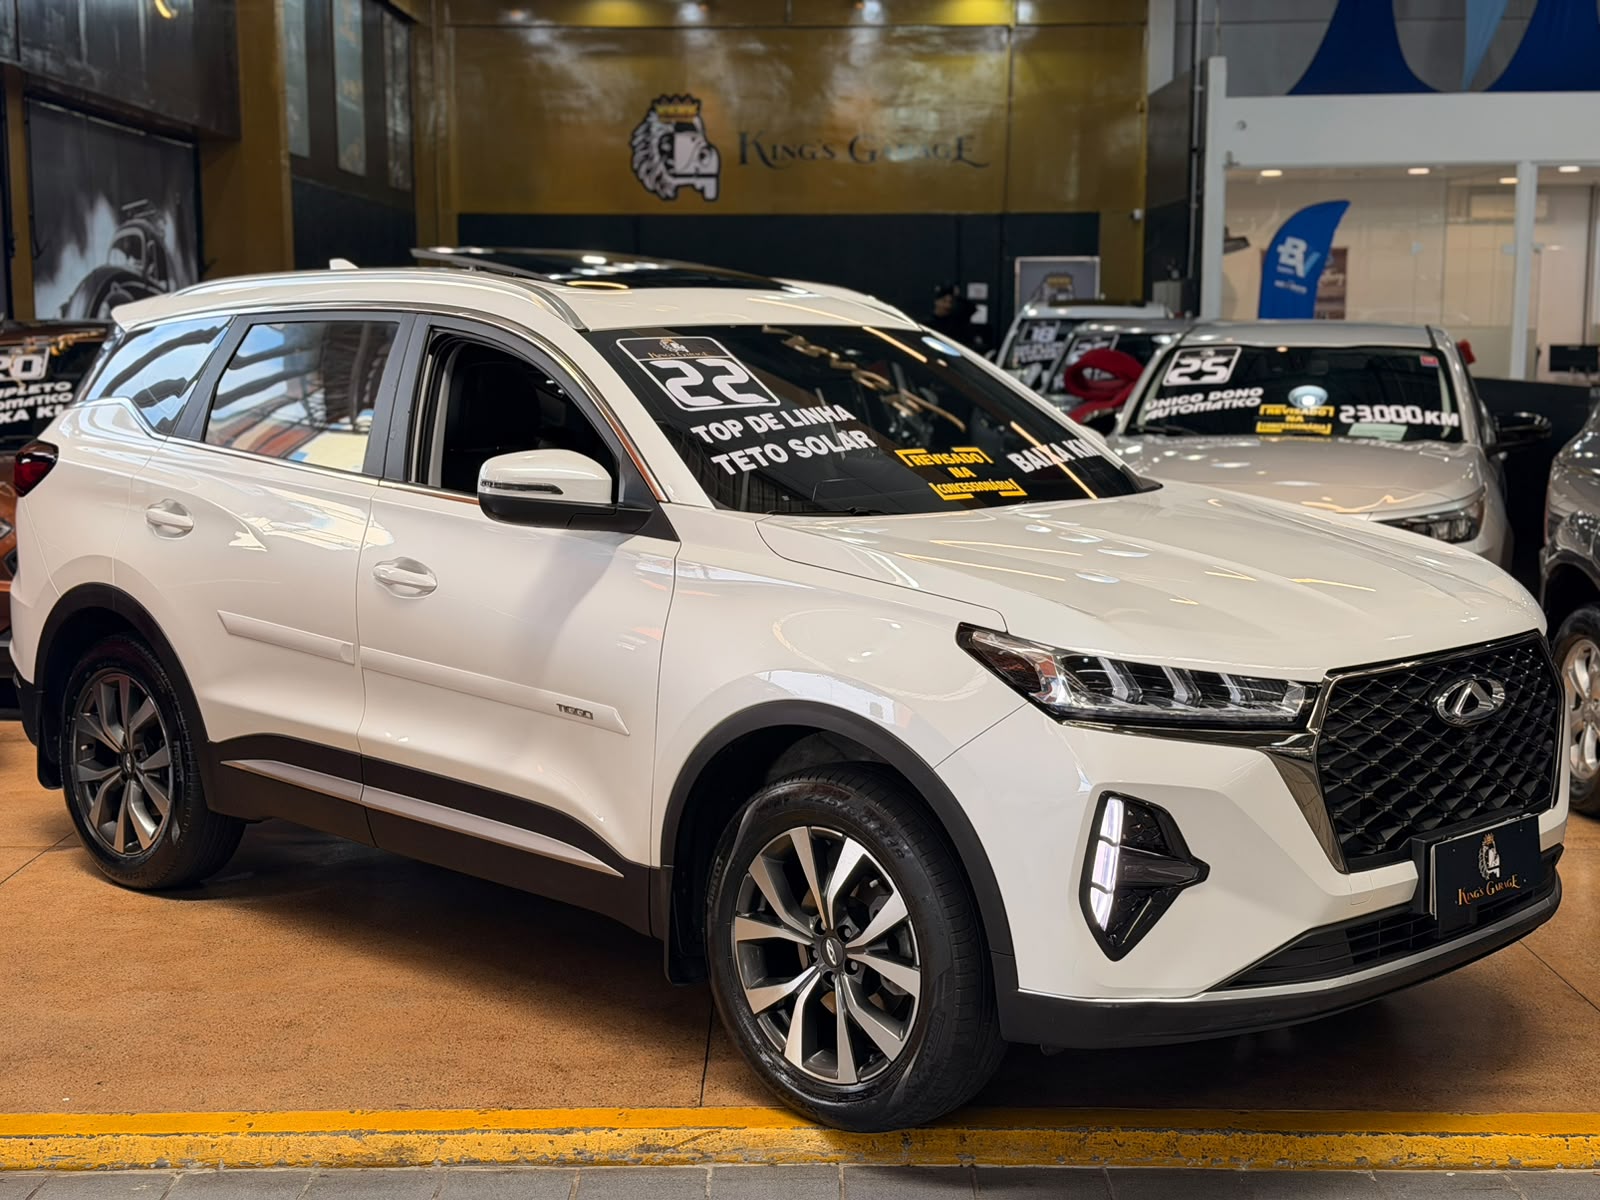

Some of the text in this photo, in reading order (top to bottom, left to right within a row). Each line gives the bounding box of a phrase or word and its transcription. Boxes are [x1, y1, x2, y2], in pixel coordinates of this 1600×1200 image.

[649, 358, 769, 407] 22
[1168, 357, 1230, 383] 25
[1208, 387, 1264, 401] DONO
[690, 419, 744, 444] TOP
[744, 412, 786, 434] DE
[780, 404, 857, 428] LINHA
[710, 430, 877, 476] TETO SOLAR
[908, 452, 985, 466] REVISADO
[1006, 443, 1076, 473] BAIXA
[947, 466, 977, 478] NA
[556, 703, 594, 720] TIGGO
